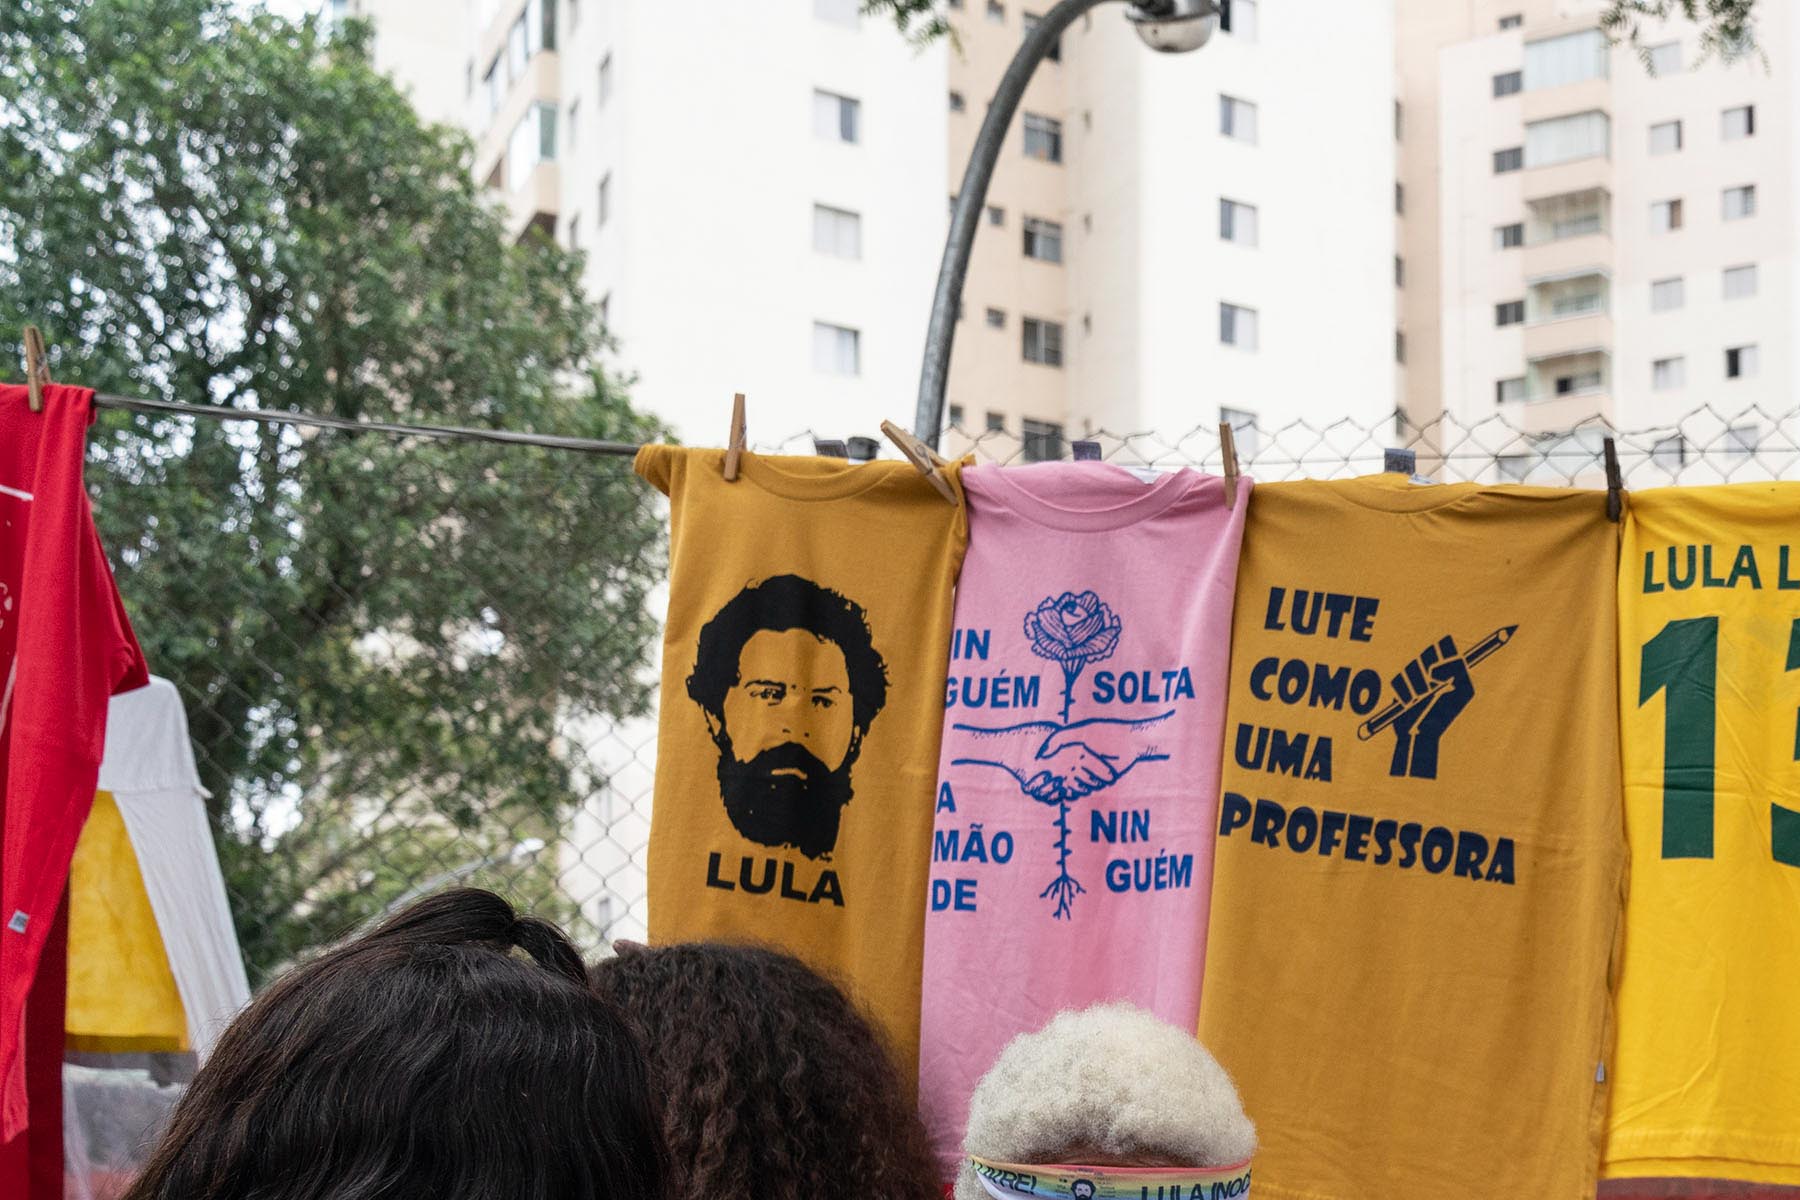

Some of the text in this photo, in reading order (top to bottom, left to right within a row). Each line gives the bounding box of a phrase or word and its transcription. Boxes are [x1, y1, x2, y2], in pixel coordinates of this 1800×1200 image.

[1642, 545, 1761, 594] LULA
[1264, 586, 1380, 643] LUTE
[1092, 666, 1196, 703] SOLTA
[1250, 657, 1381, 715] COMO
[1234, 722, 1333, 782] UMA
[936, 781, 956, 813] A
[934, 824, 1014, 863] MÃO
[1091, 810, 1150, 843] NIN
[1219, 792, 1515, 885] PROFESSORA
[705, 852, 845, 907] LULA
[1106, 849, 1193, 893] GUÉM
[931, 879, 977, 912] DE
